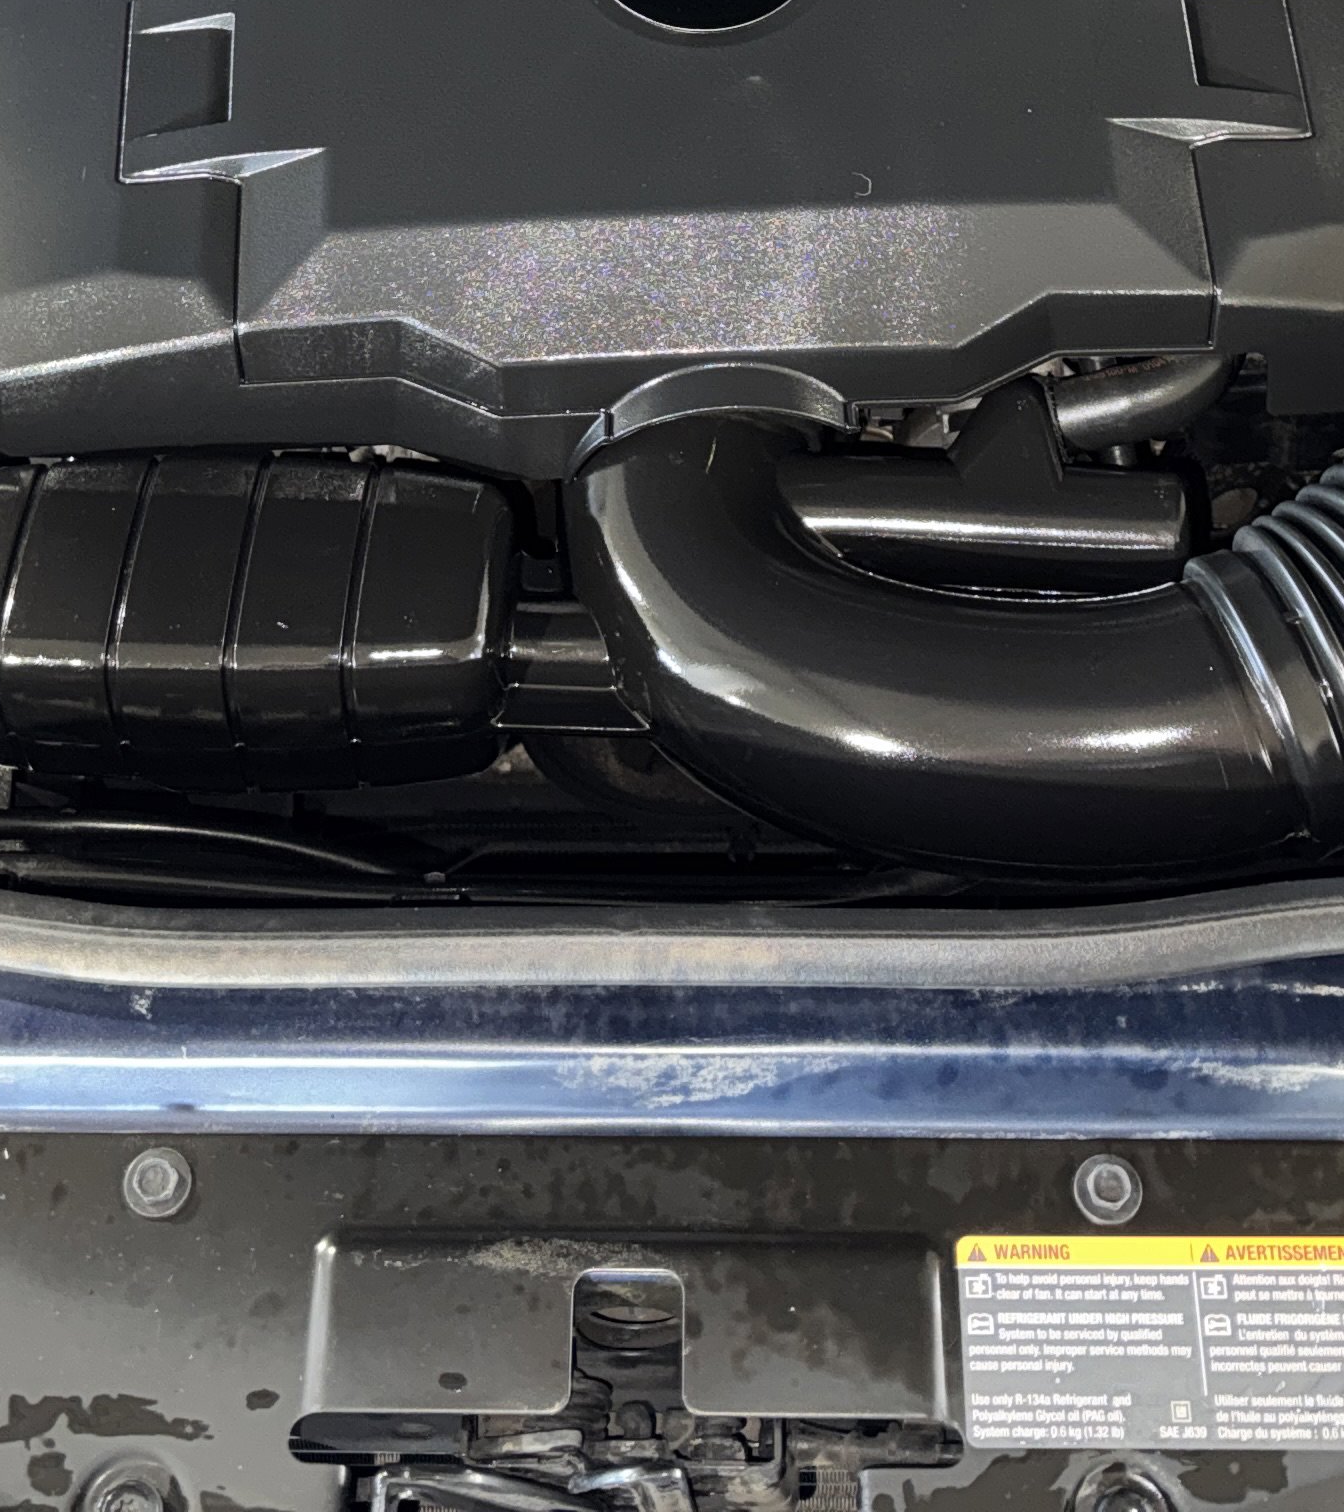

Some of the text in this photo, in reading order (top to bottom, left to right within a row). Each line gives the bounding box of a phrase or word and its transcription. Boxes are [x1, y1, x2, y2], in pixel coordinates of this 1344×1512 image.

[994, 1244, 1070, 1260] WARNING
[996, 1273, 1189, 1288] To help avoid personal injury, keep hands
[1233, 1274, 1275, 1285] Attention
[1278, 1276, 1296, 1285] aux
[1298, 1275, 1330, 1287] doigts!
[997, 1289, 1165, 1302] clear of fan. It can start at any time.
[1234, 1290, 1256, 1302] peut
[1258, 1292, 1270, 1301] se
[1272, 1290, 1304, 1301] mettre
[998, 1313, 1184, 1324] REFRIGERANT UNDER HIGH PRESSURE
[1237, 1313, 1272, 1325] FLUIDE
[999, 1329, 1162, 1343] System to be serviced by qualified
[1293, 1329, 1307, 1341] du
[969, 1343, 1192, 1359] personnel only. Improper service methods may
[1210, 1344, 1256, 1357] personnel
[970, 1359, 1074, 1373] cause personal injury.
[1211, 1361, 1264, 1372] incorrectes
[1267, 1361, 1306, 1373] peuvent
[1308, 1362, 1341, 1372] causer
[972, 1394, 1131, 1407] Use only R-134a Refrigerant and
[1215, 1394, 1248, 1406] Utiliser
[1251, 1394, 1302, 1407] seulement
[1305, 1394, 1313, 1407] le
[1316, 1394, 1344, 1407] fluide
[972, 1410, 1033, 1423] Polyalkylene
[1036, 1410, 1065, 1423] Glycol
[1068, 1410, 1079, 1421] oil
[1082, 1410, 1105, 1422] (PAG
[1216, 1410, 1229, 1422] de
[1263, 1413, 1276, 1423] au
[973, 1426, 1010, 1438] System
[1012, 1426, 1049, 1439] charge:
[1069, 1426, 1081, 1439] kg
[1084, 1426, 1108, 1439] (1.32
[1110, 1426, 1124, 1438] lb)
[1159, 1426, 1207, 1438] SAE J639
[1218, 1427, 1253, 1441] Charge
[1255, 1427, 1268, 1439] du
[1270, 1427, 1311, 1441] système
